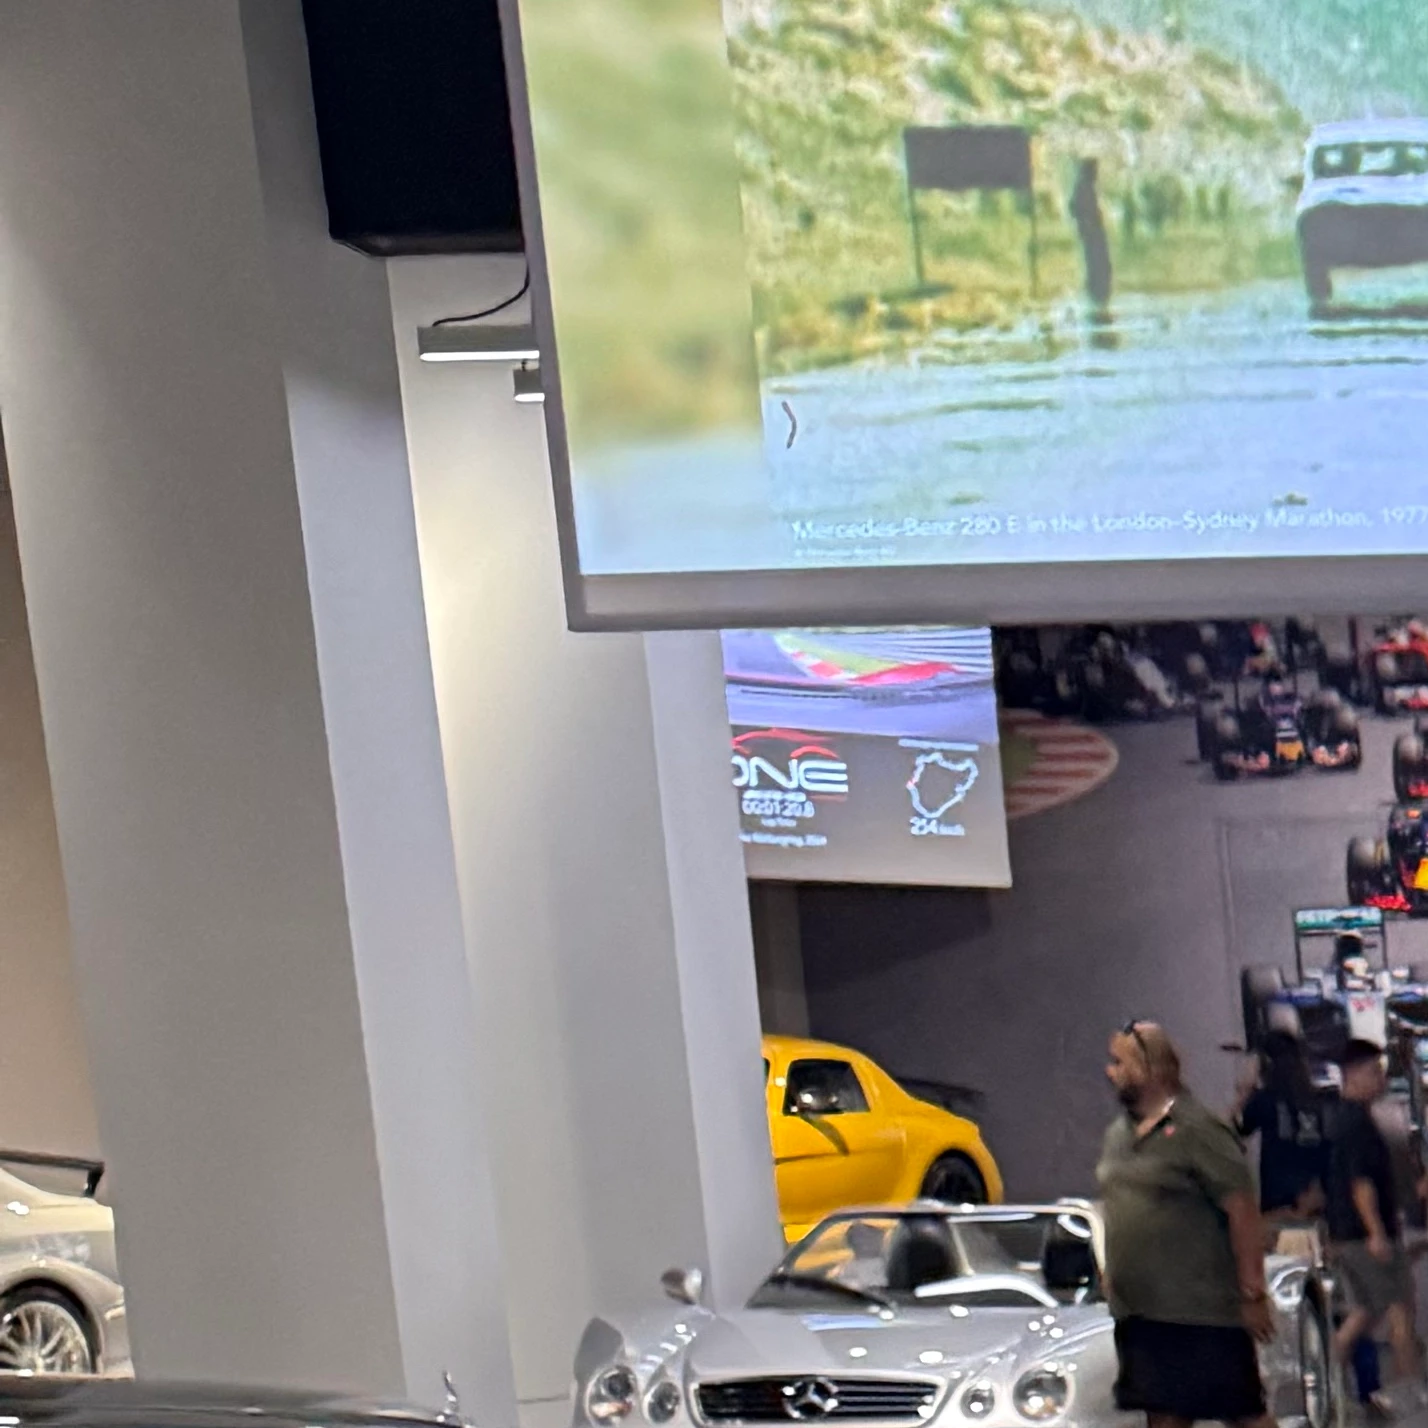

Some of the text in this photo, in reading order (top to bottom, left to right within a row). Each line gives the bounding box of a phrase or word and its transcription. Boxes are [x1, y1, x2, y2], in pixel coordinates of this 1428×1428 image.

[960, 517, 1000, 536] 280
[1007, 513, 1019, 534] E
[1027, 512, 1047, 533] in
[1050, 511, 1083, 533] the
[1093, 508, 1258, 536] London-Sydney
